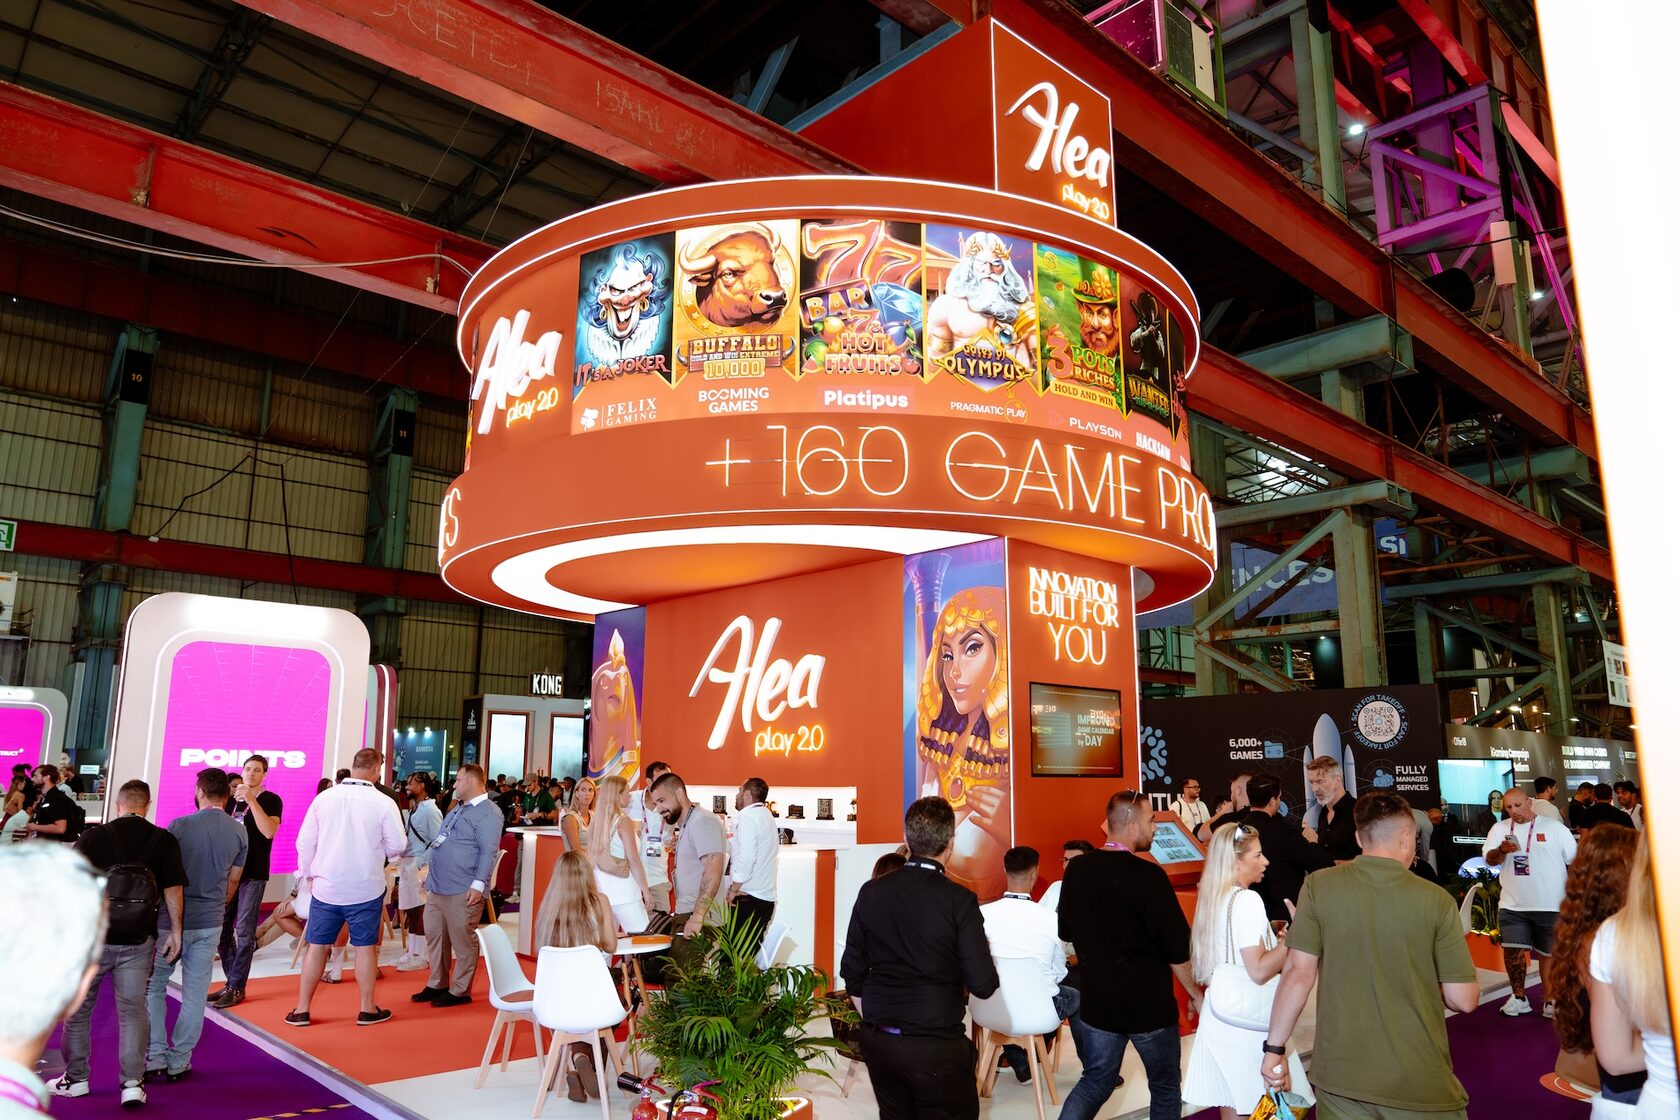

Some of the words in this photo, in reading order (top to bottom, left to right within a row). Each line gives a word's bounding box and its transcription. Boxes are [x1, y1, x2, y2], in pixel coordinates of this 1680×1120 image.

[1004, 82, 1111, 188] Alea
[805, 287, 869, 321] BAR
[693, 335, 777, 355] BUFFALO
[841, 333, 887, 352] HOT
[602, 365, 614, 380] A
[615, 354, 671, 376] JOKER
[825, 353, 902, 375] FRUITS
[1048, 332, 1074, 380] 3
[1071, 345, 1115, 375] POTS
[132, 373, 143, 382] 10
[471, 309, 563, 434] Alea
[707, 361, 761, 378] 10,000
[944, 356, 1024, 380] OLYMPUS
[1073, 366, 1116, 389] RICHES
[823, 389, 909, 409] Platipus
[1054, 383, 1079, 396] HOLD
[1080, 390, 1098, 402] AND
[1099, 395, 1114, 406] WIN
[1128, 377, 1170, 409] WANTED
[506, 399, 537, 428] play
[607, 397, 657, 417] FELIX
[708, 400, 759, 413] GAMES
[950, 401, 1004, 415] PRAGMATIC
[1006, 407, 1026, 419] PLAY
[606, 411, 657, 427] GAMING
[1069, 417, 1122, 440] PLAYSON
[945, 431, 1145, 524] GAME
[1029, 588, 1075, 621] BUILT
[1082, 599, 1120, 628] FOR
[1047, 622, 1107, 665] YOU
[532, 674, 563, 695] KONG
[688, 614, 826, 750] Alea
[1351, 703, 1362, 722] SCAN
[1361, 695, 1376, 706] FOR
[1376, 694, 1406, 714] TAKEOFF
[754, 726, 795, 757] play
[1085, 735, 1103, 746] DAY
[1353, 731, 1383, 750] TAKEOFF
[1396, 721, 1408, 741] SCAN
[1228, 738, 1263, 749] 6,000+
[1383, 739, 1399, 749] FOR
[1230, 750, 1264, 760] GAMES
[1395, 765, 1427, 774] FULLY
